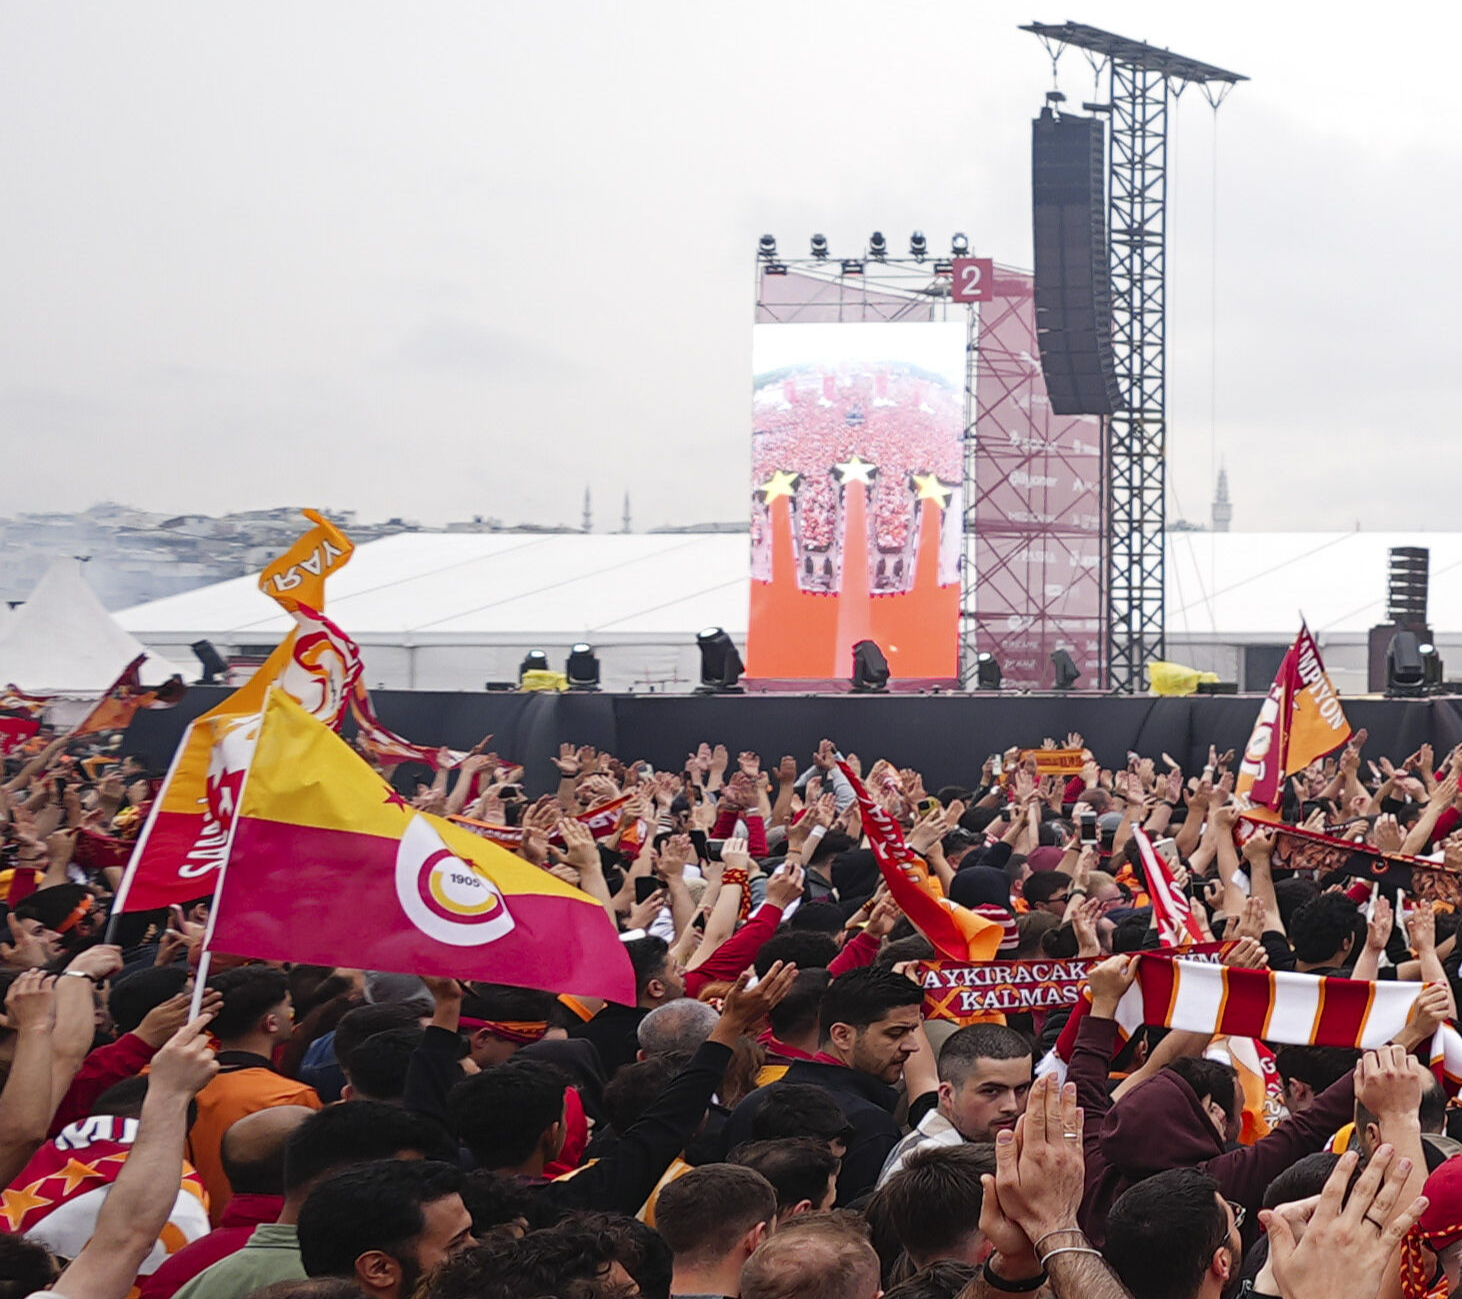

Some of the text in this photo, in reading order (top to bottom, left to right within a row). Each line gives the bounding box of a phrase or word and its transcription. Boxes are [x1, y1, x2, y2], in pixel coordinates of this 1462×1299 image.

[961, 266, 982, 295] 2
[450, 873, 481, 888] 1905
[960, 982, 1091, 1012] KALMAS
